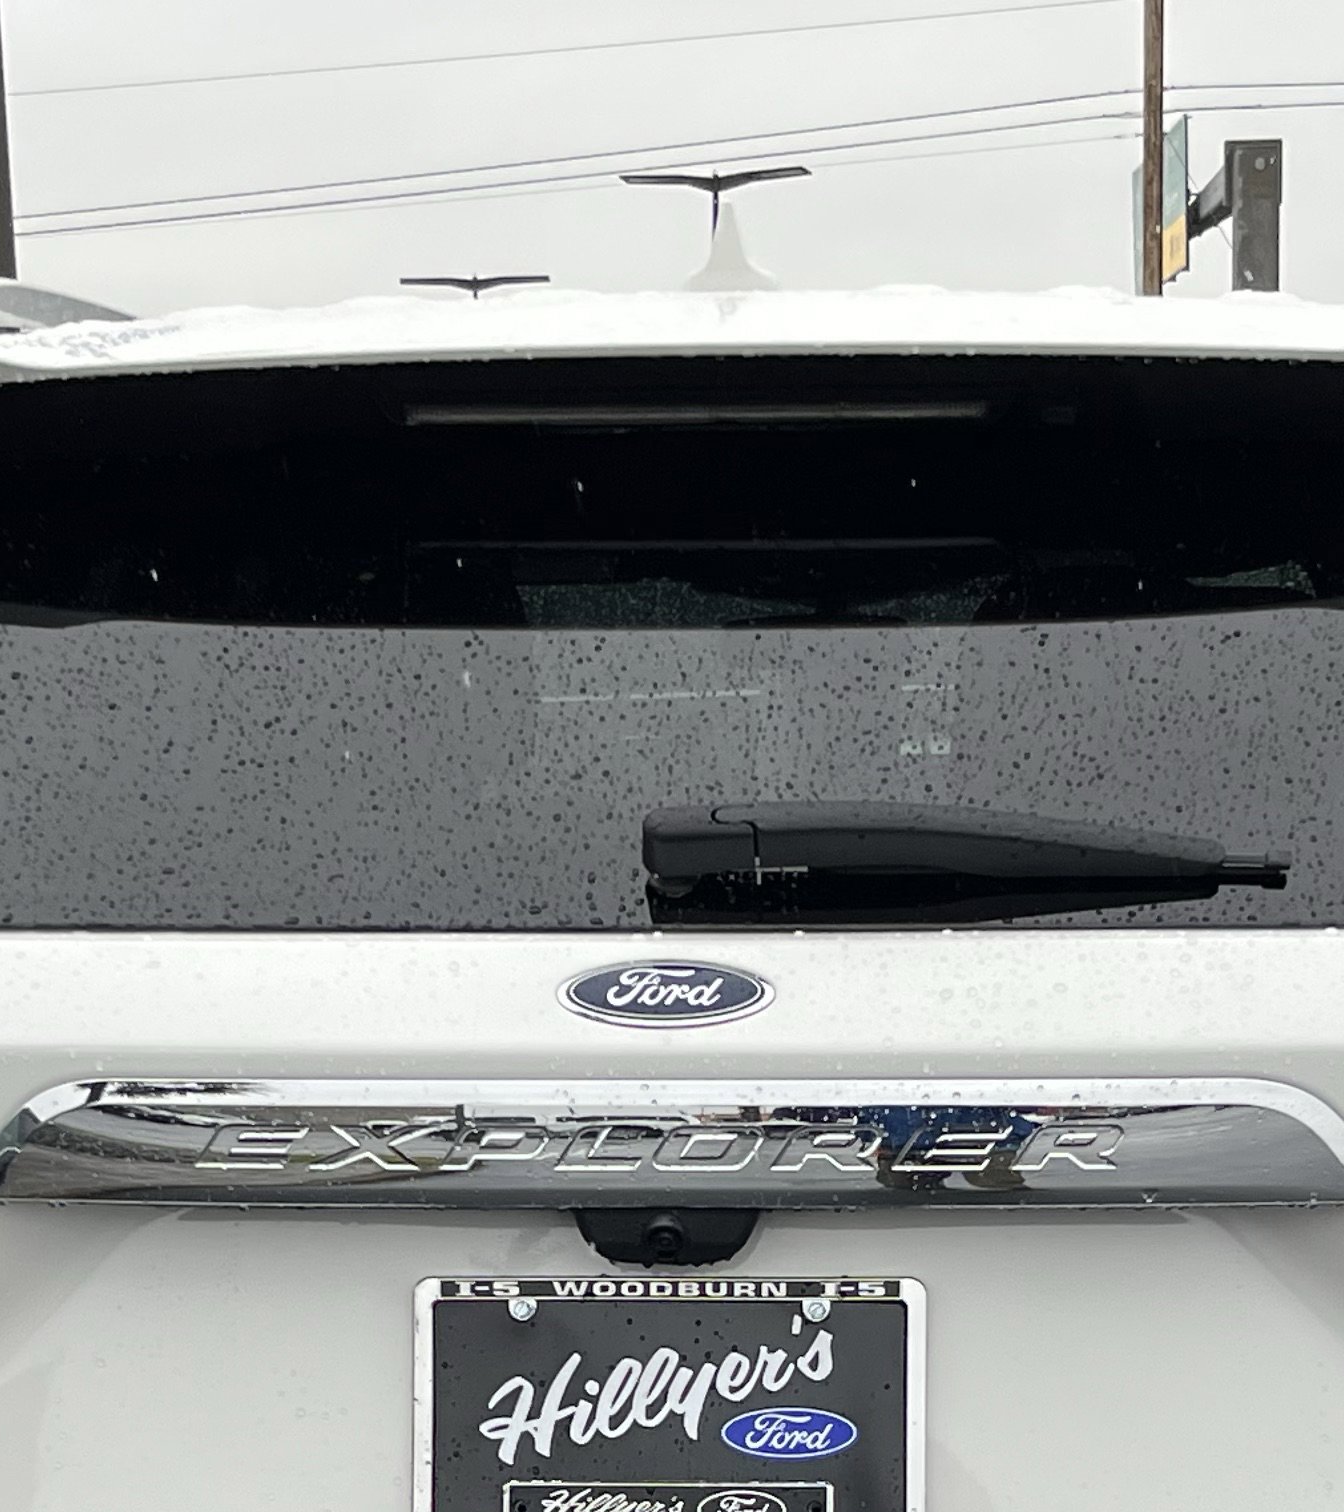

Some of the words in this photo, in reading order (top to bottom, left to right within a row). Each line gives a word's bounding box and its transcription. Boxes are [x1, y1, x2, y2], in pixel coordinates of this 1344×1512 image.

[607, 968, 724, 1006] Ford
[195, 1123, 1125, 1172] EXPLORER
[455, 1281, 520, 1296] I-5
[552, 1281, 786, 1297] WOODBURN
[820, 1281, 886, 1297] I-5
[479, 1314, 834, 1465] Hillyer's
[744, 1412, 833, 1452] Ford
